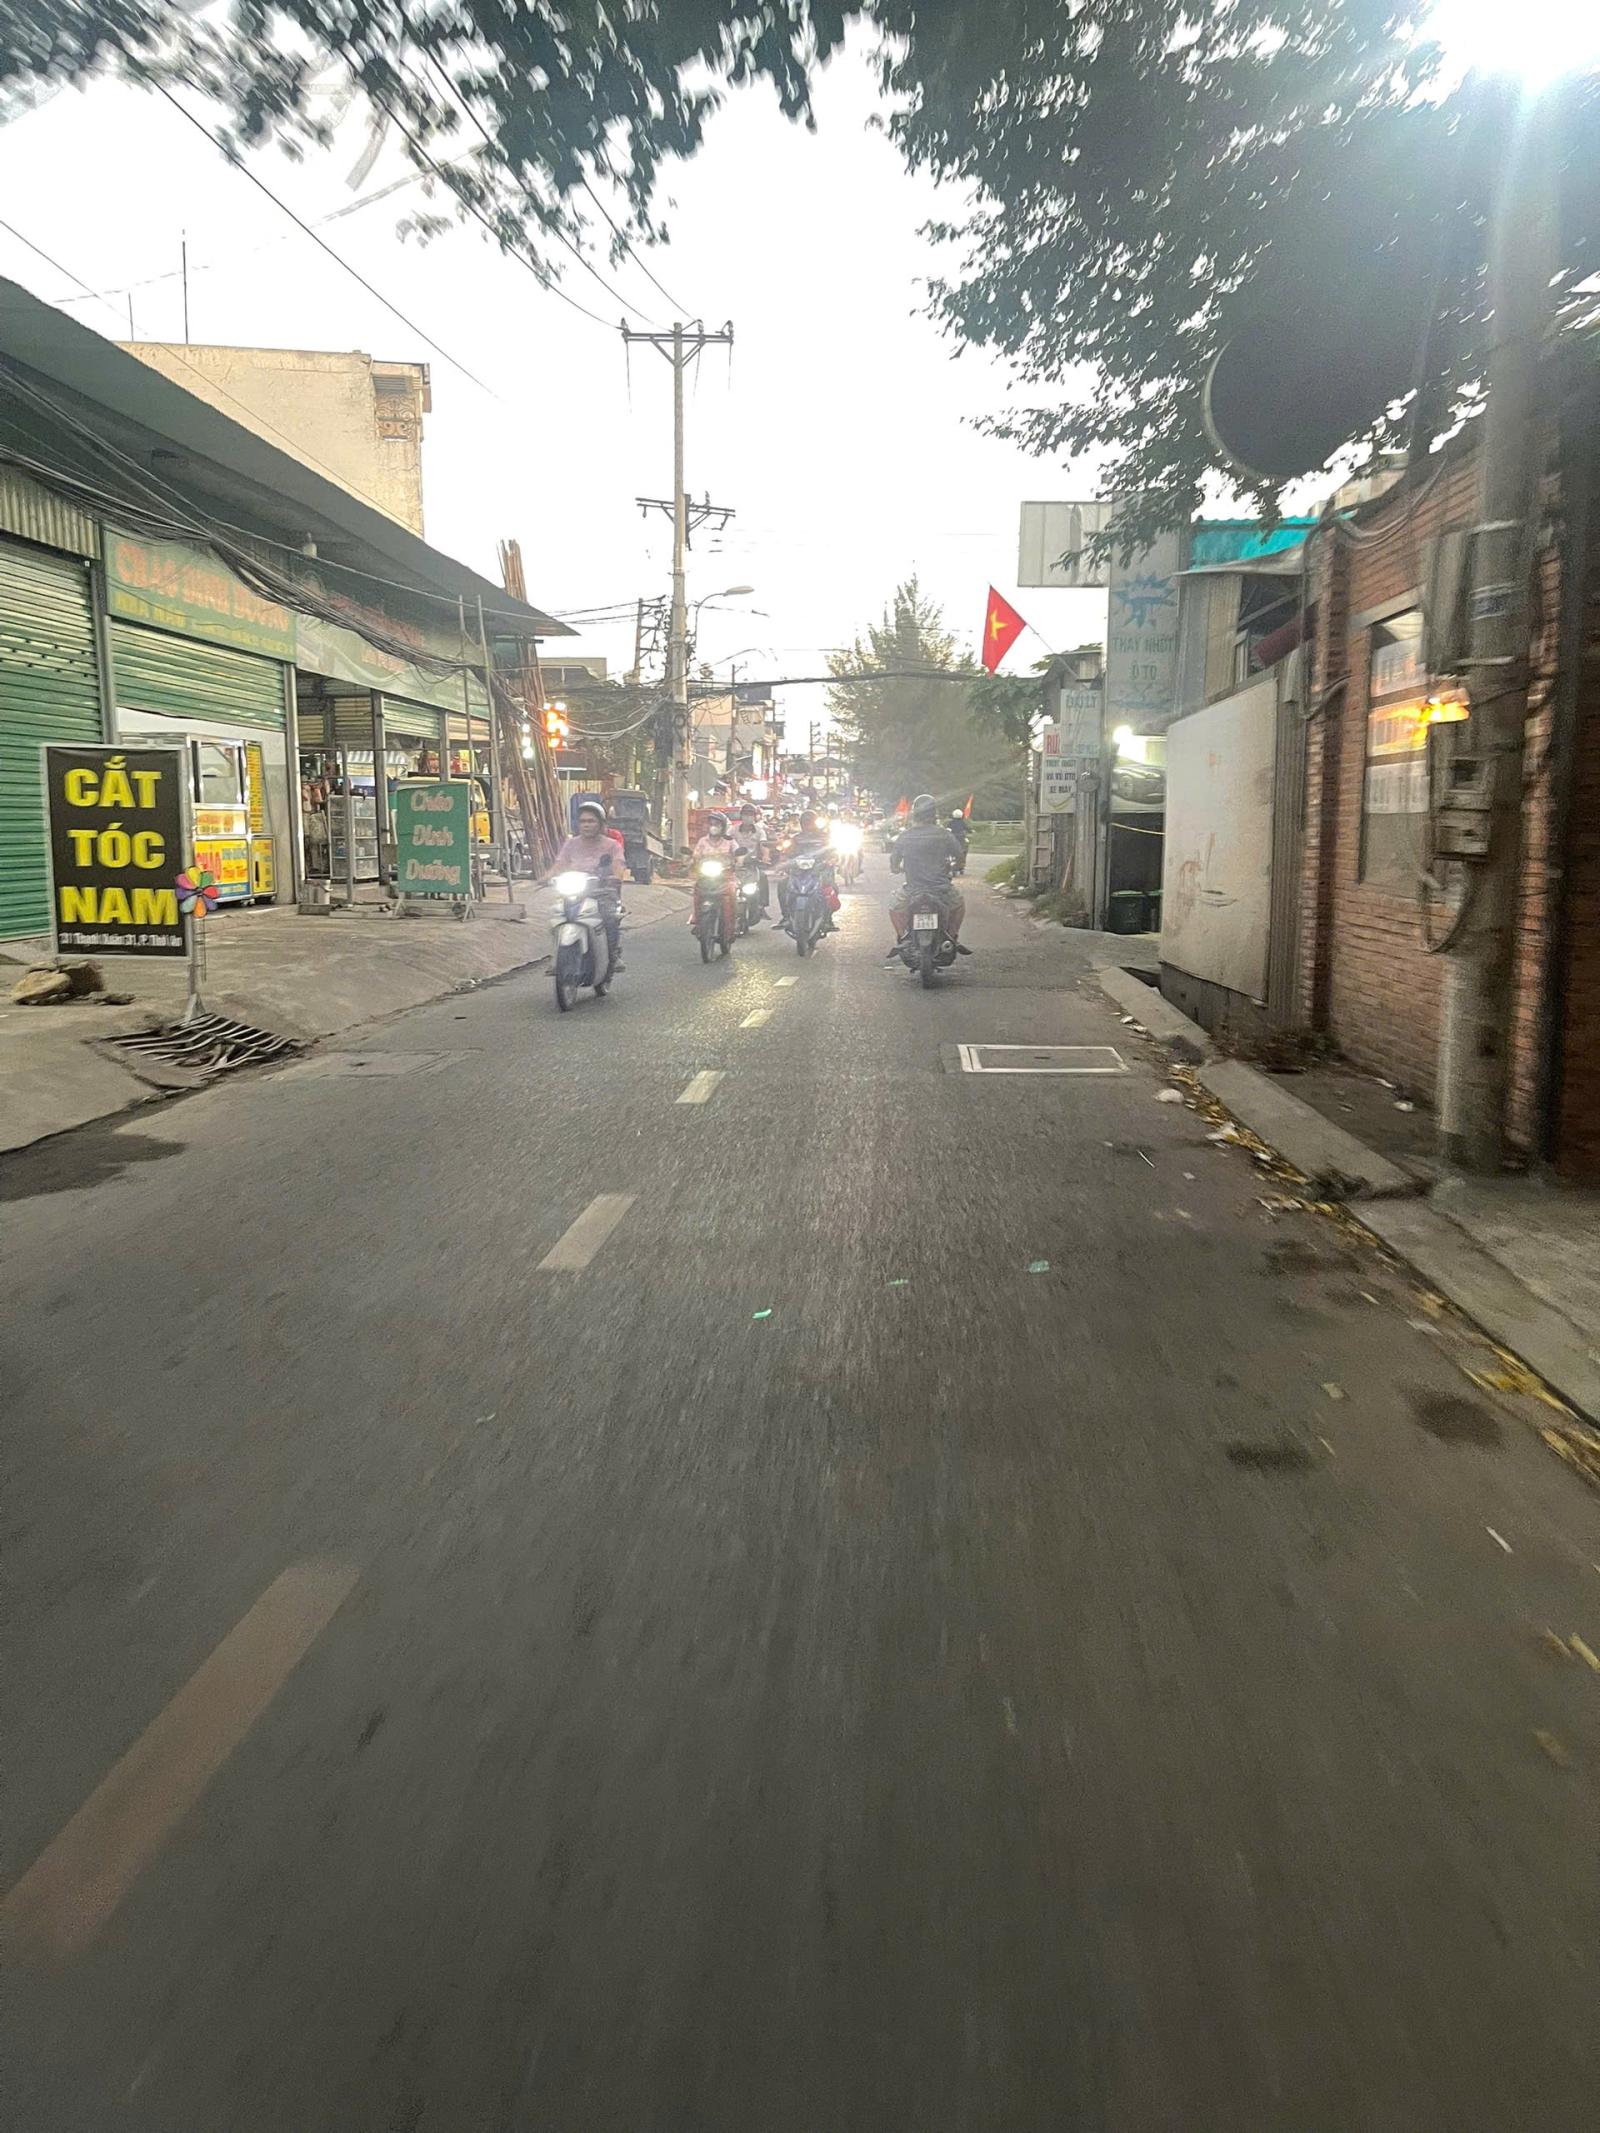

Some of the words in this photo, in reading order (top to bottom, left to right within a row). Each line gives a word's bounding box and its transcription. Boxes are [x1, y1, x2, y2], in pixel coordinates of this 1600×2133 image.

[64, 756, 162, 808] CẮT
[67, 823, 165, 869] TÓC
[59, 886, 179, 925] NAM
